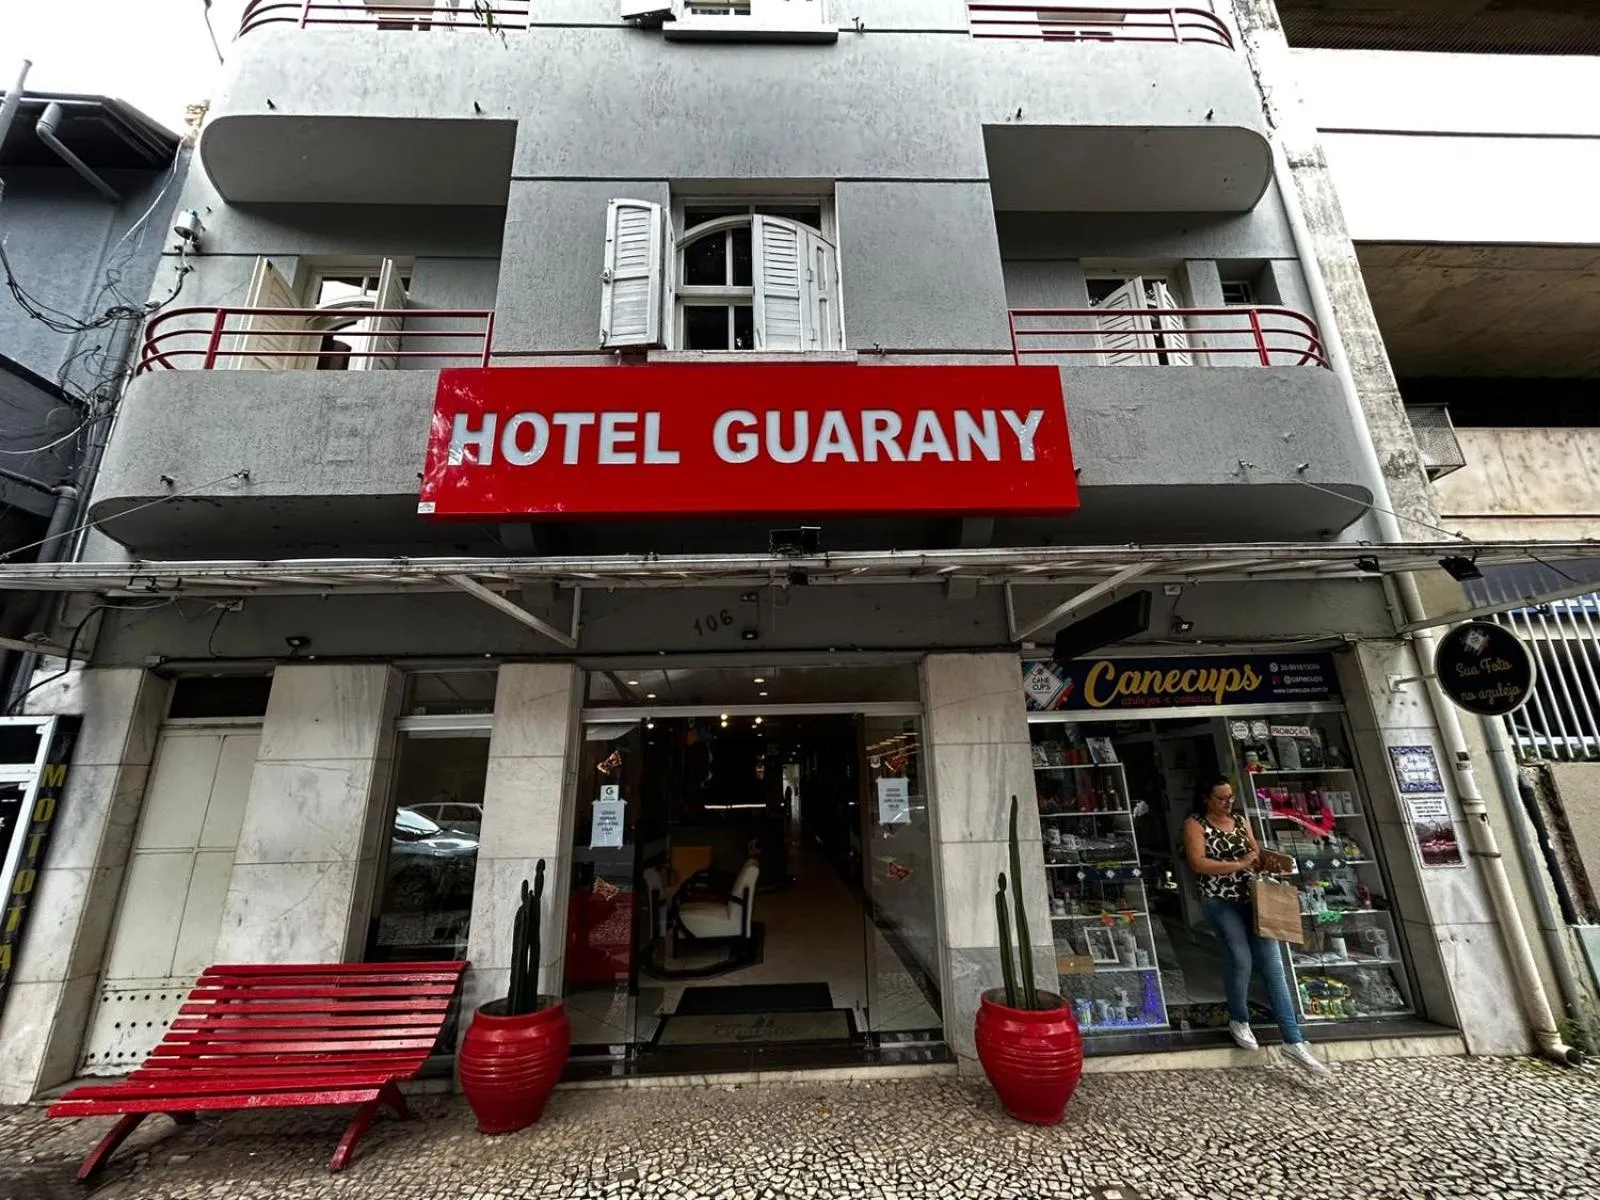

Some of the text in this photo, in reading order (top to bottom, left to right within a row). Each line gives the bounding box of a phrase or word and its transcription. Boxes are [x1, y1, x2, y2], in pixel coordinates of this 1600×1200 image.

[446, 408, 1045, 467] HOTEL GUARANY
[693, 609, 733, 636] 106
[1032, 676, 1049, 684] CANE
[1456, 662, 1480, 678] Sua
[1032, 683, 1051, 691] CUPS
[1084, 660, 1262, 708] Canecups
